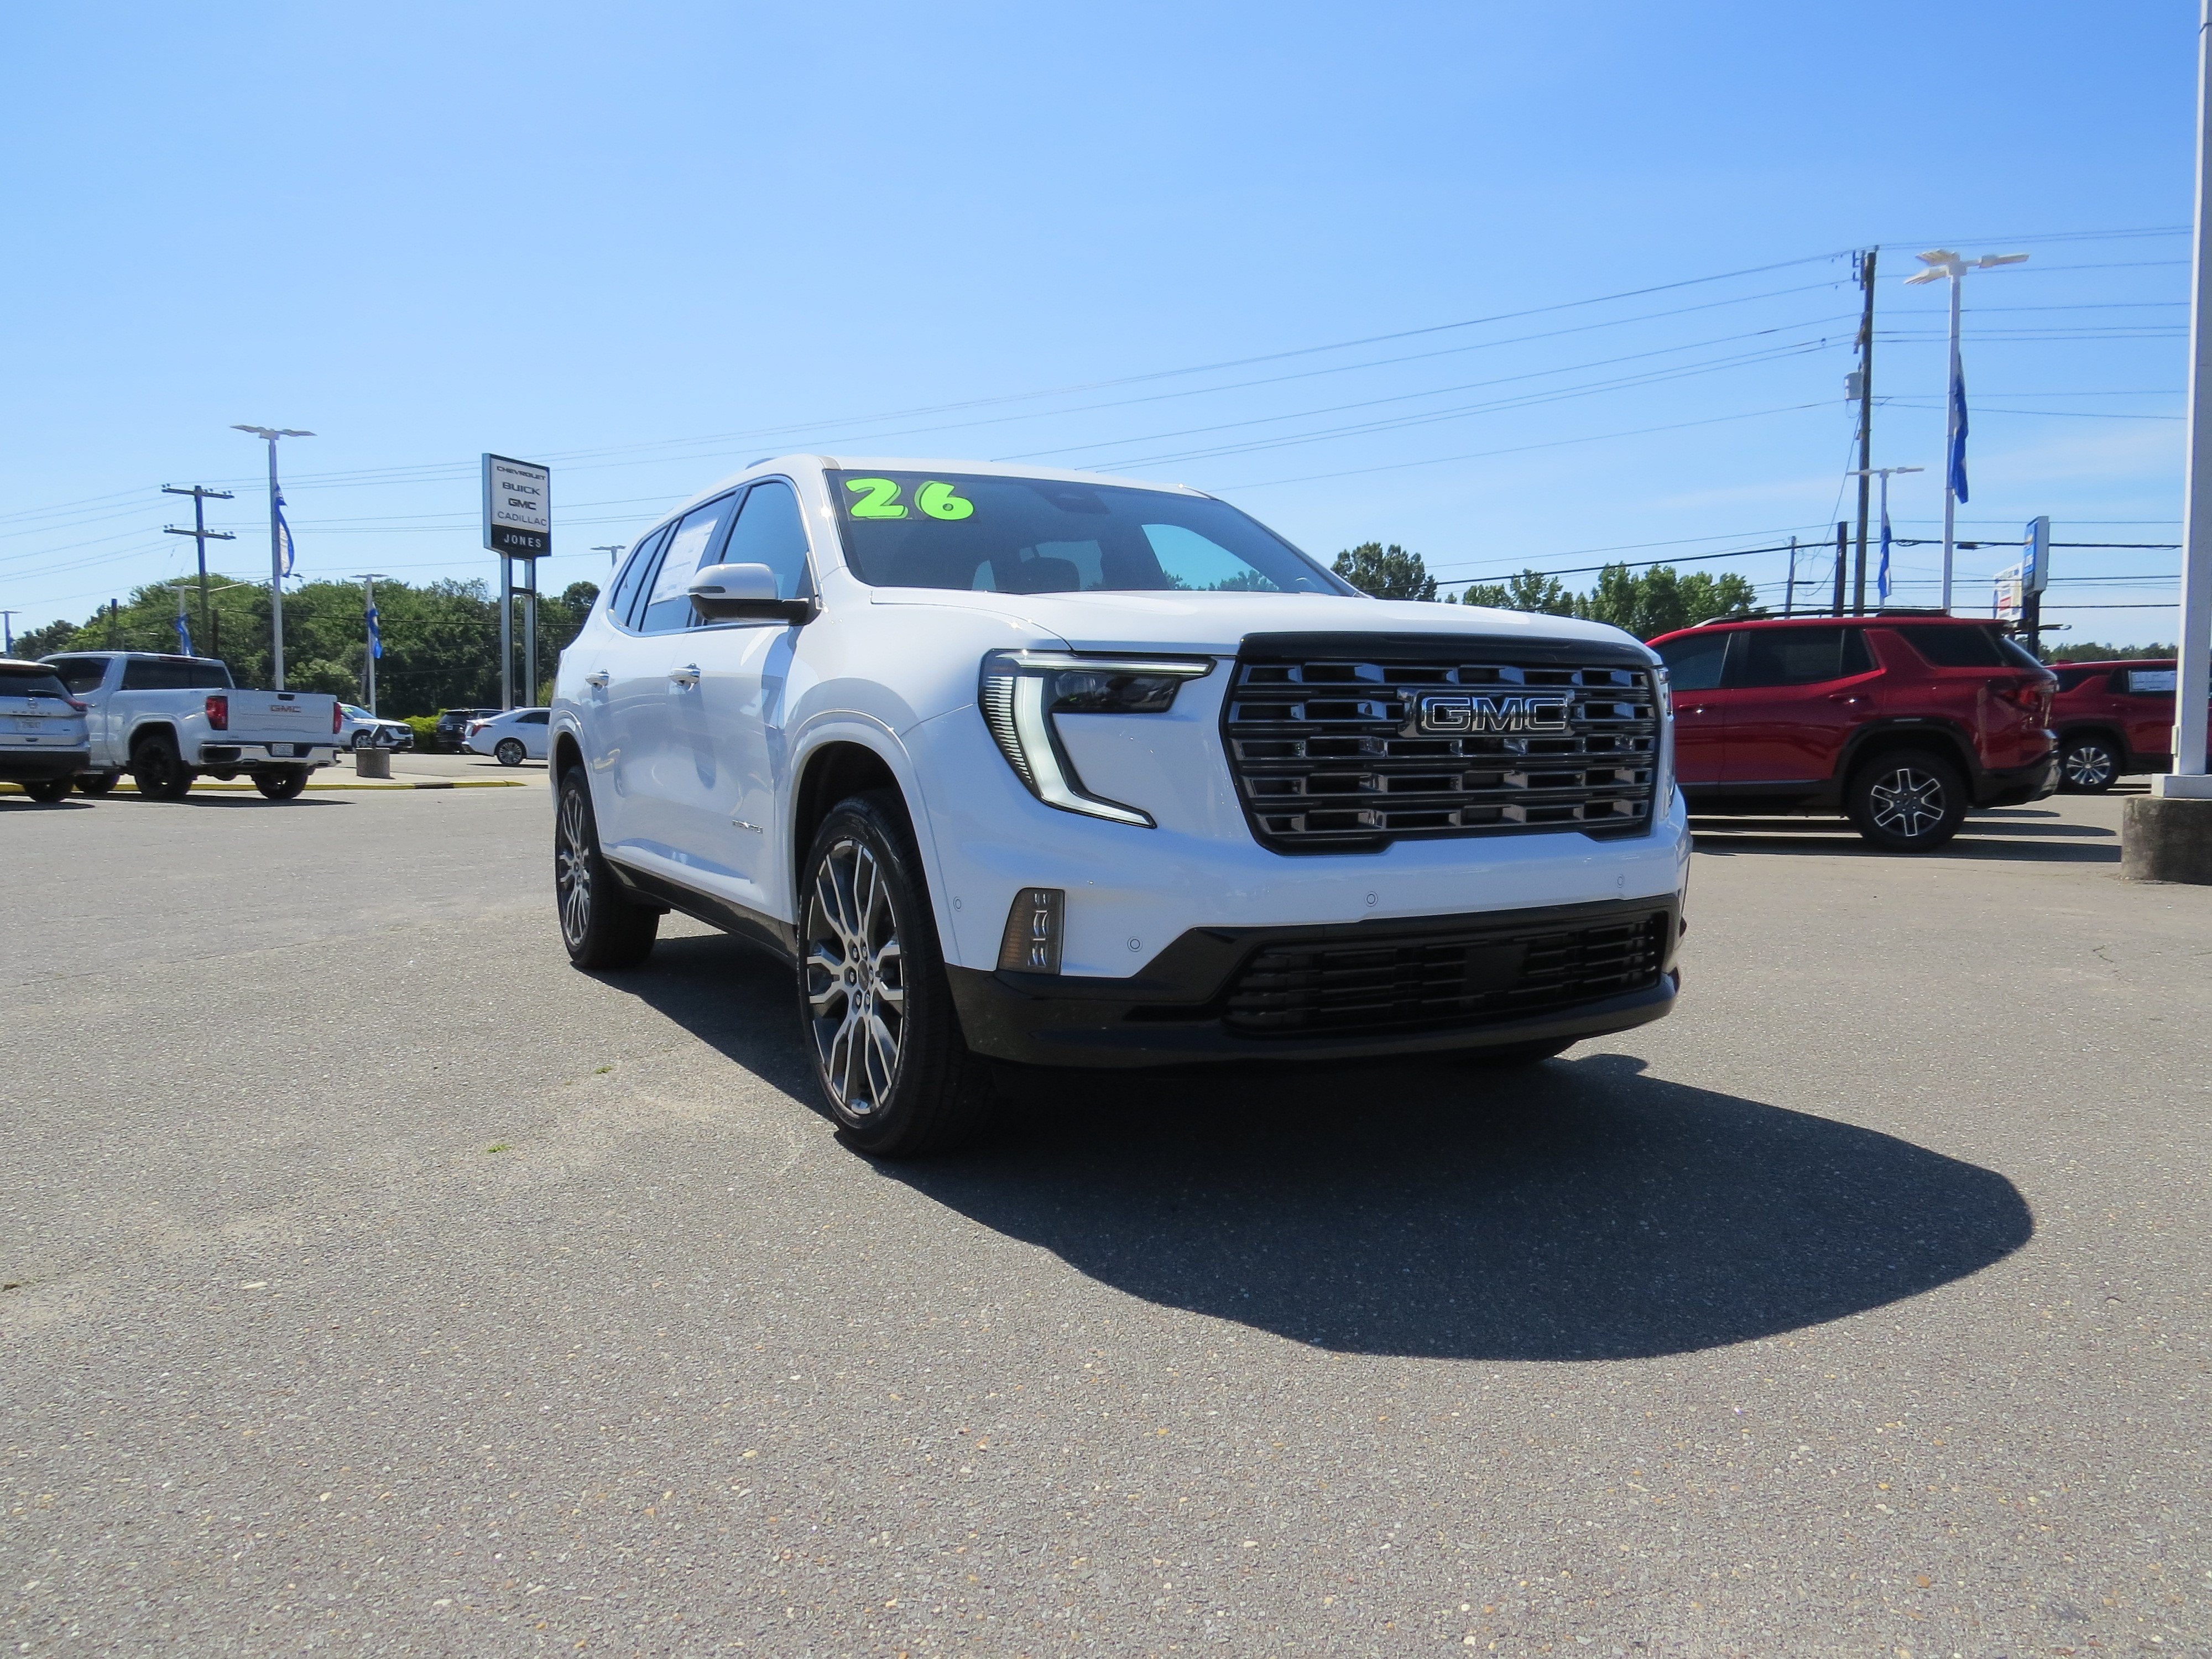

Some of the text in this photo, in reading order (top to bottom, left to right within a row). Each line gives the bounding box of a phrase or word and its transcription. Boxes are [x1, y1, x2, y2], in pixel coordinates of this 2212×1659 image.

[497, 466, 546, 481] CHEVROLET
[502, 482, 541, 496] BUICK
[508, 498, 536, 510] GMC
[845, 477, 974, 520] 26
[498, 511, 547, 526] CADILLAC
[504, 534, 542, 548] JONES
[1421, 697, 1567, 731] GMC
